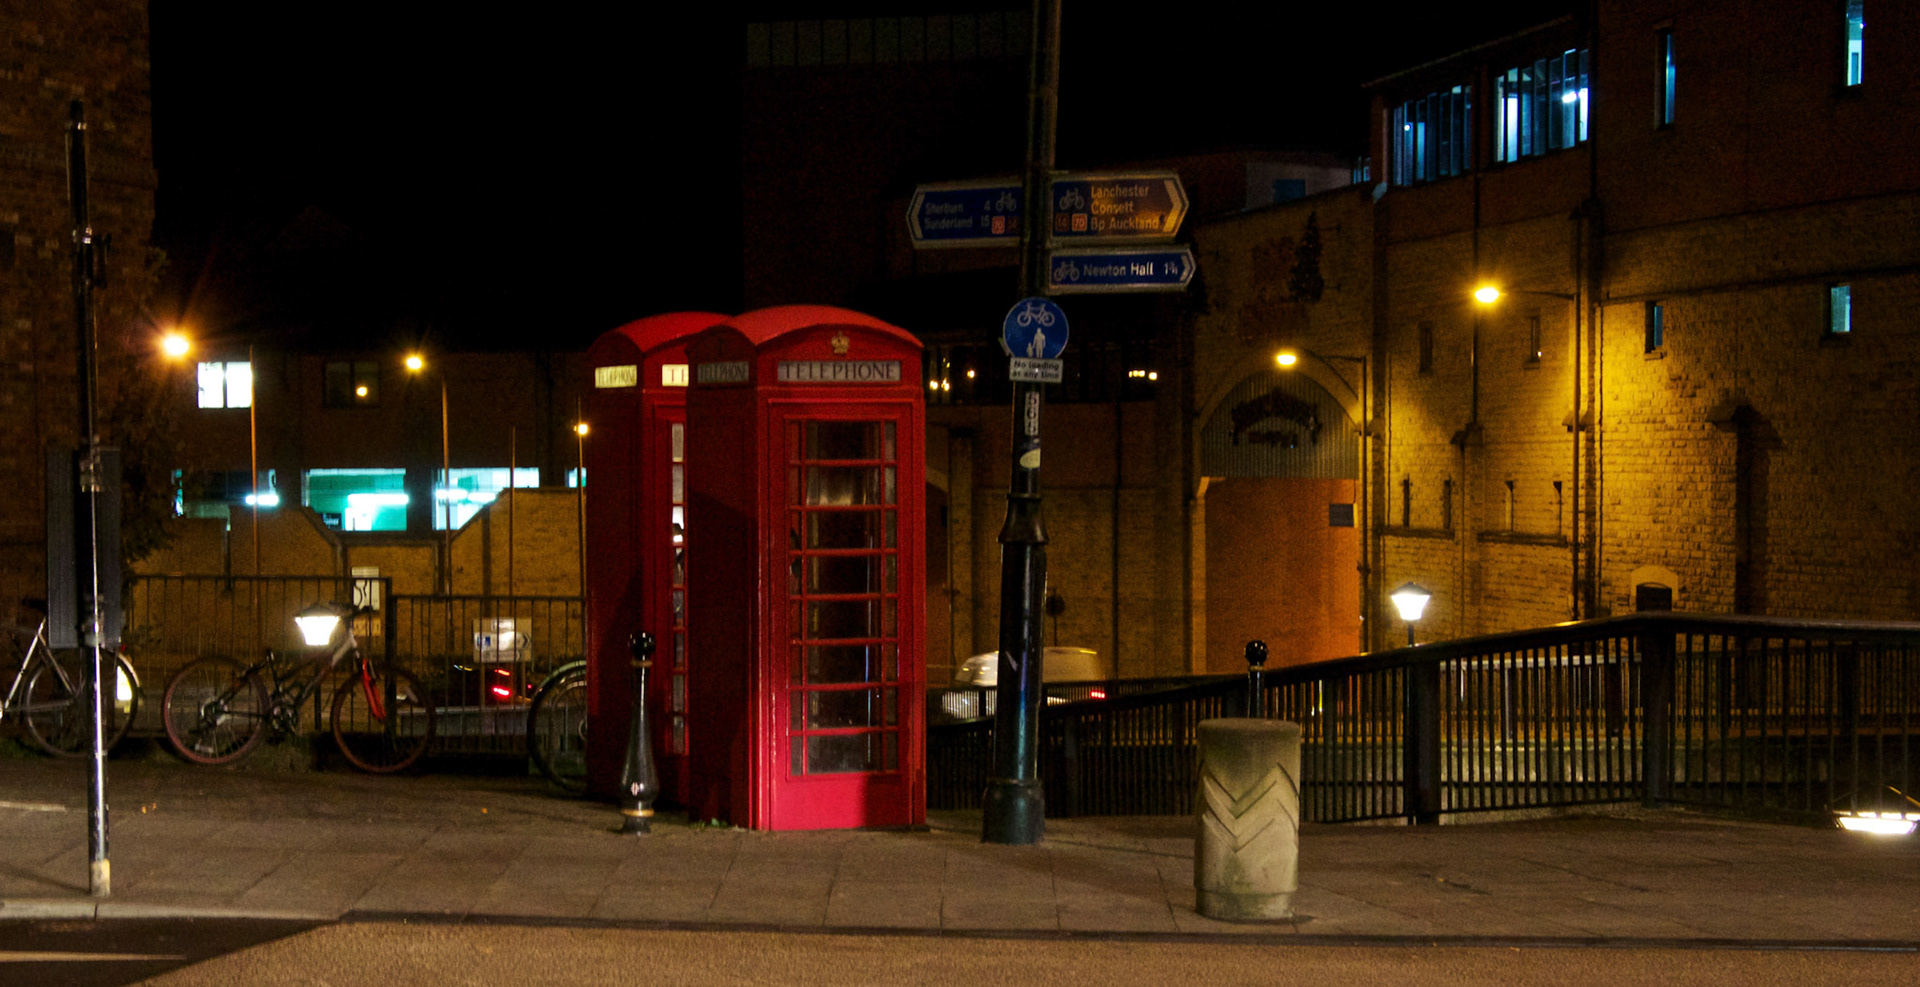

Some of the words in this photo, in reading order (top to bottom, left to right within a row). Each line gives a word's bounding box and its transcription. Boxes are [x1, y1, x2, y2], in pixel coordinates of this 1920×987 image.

[1091, 184, 1150, 198] Lanchester
[1091, 199, 1134, 215] Consett
[924, 215, 973, 230] Sunderland
[1091, 217, 1105, 231] Bp
[1109, 215, 1160, 229] Auckland
[1083, 262, 1126, 276] Newton
[1130, 261, 1154, 276] Hall
[784, 363, 895, 380] TELEPHONE
[1014, 360, 1026, 368] No
[1029, 360, 1059, 371] loading
[1041, 370, 1059, 379] time
